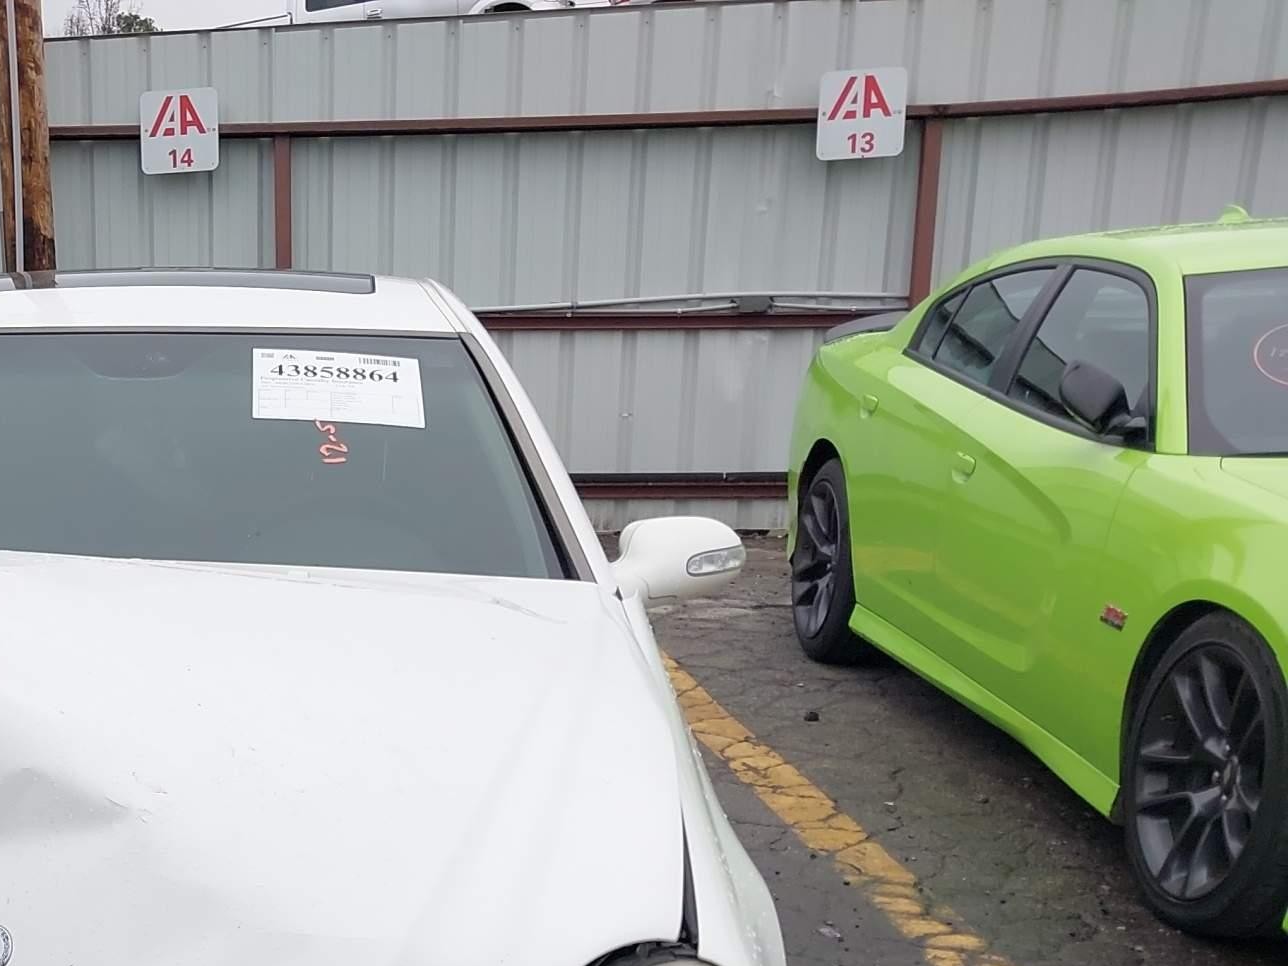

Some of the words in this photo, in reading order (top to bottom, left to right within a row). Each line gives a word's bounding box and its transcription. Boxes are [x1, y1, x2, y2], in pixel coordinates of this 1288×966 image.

[847, 132, 875, 154] 13
[168, 148, 194, 168] 14
[270, 364, 400, 383] 43858864
